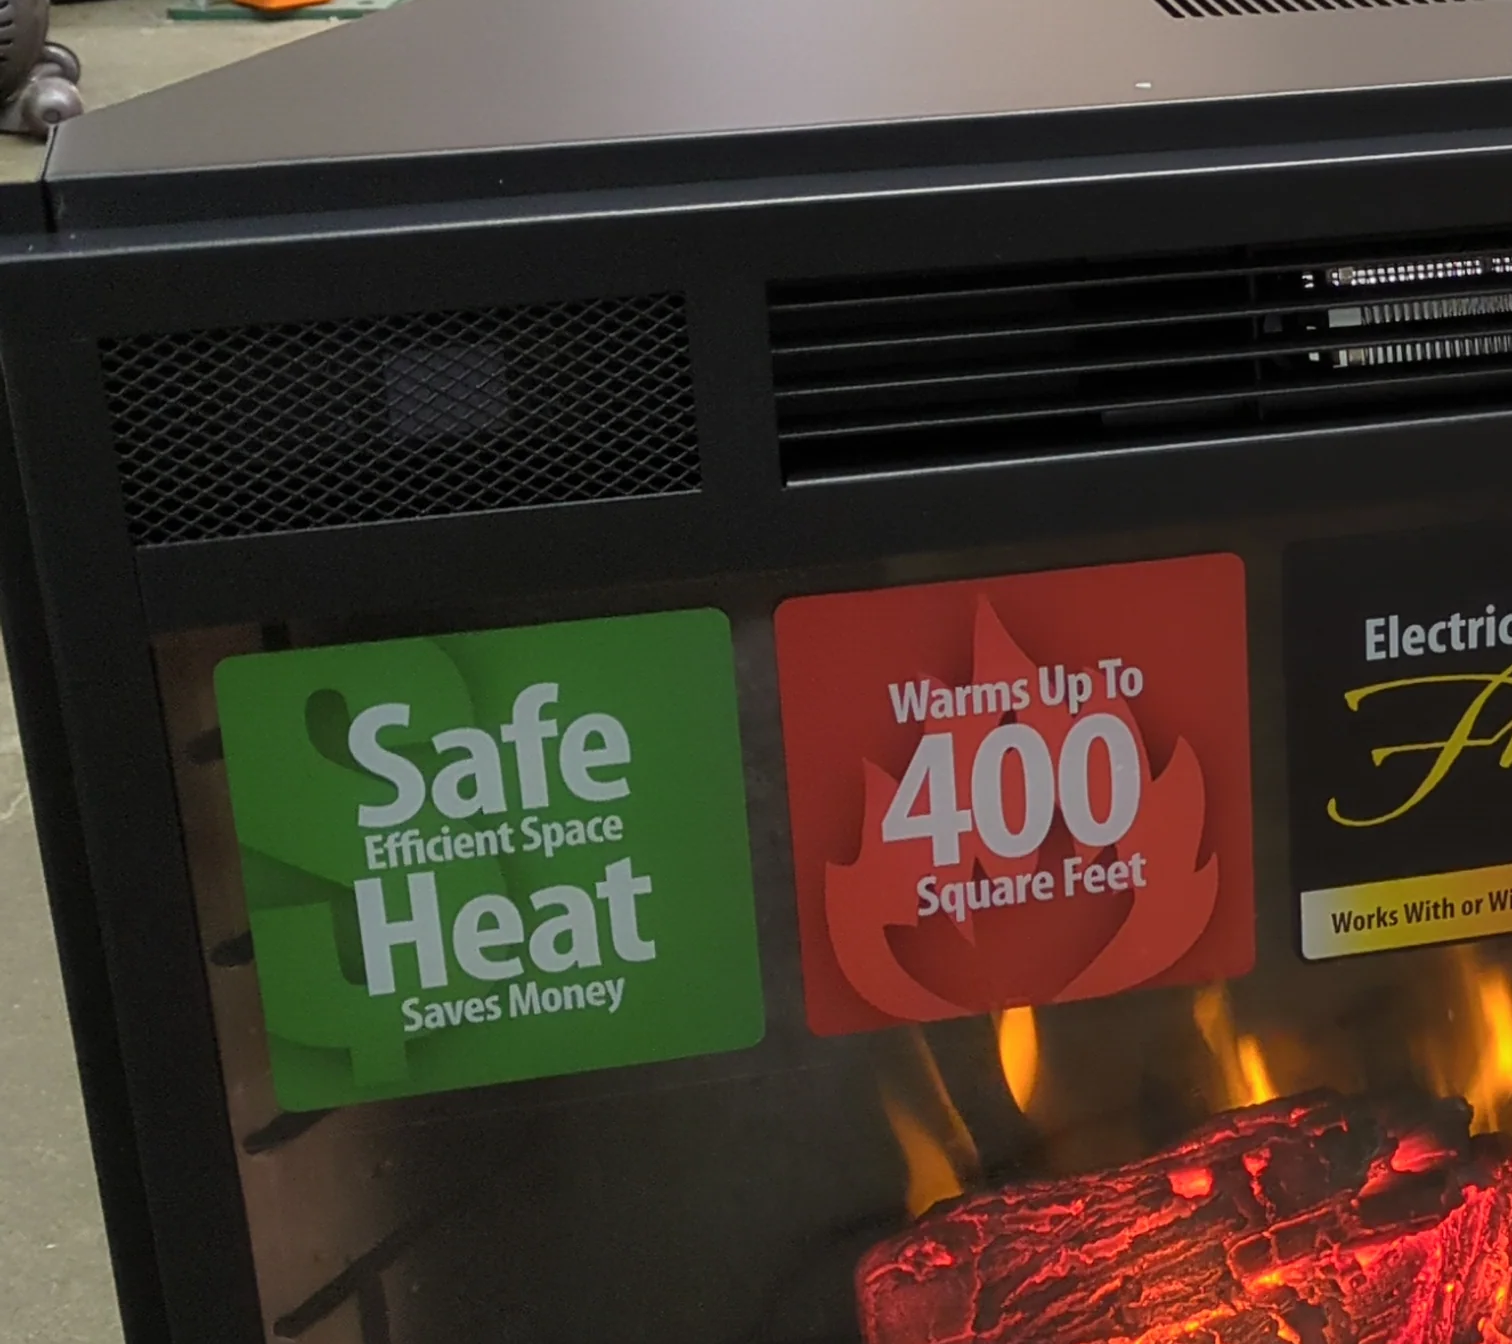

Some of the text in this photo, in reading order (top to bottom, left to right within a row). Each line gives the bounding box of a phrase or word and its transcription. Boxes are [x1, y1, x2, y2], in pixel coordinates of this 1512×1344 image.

[888, 658, 1144, 724] Warms Up To
[348, 681, 632, 829] Safe
[881, 712, 1141, 868] 400
[364, 814, 624, 871] Efficient Space
[917, 853, 1147, 922] Square Feet
[1331, 906, 1399, 934] Works
[1404, 895, 1455, 924] With
[1461, 898, 1483, 916] or
[354, 857, 657, 997] Heat
[401, 977, 626, 1032] Saves Money
